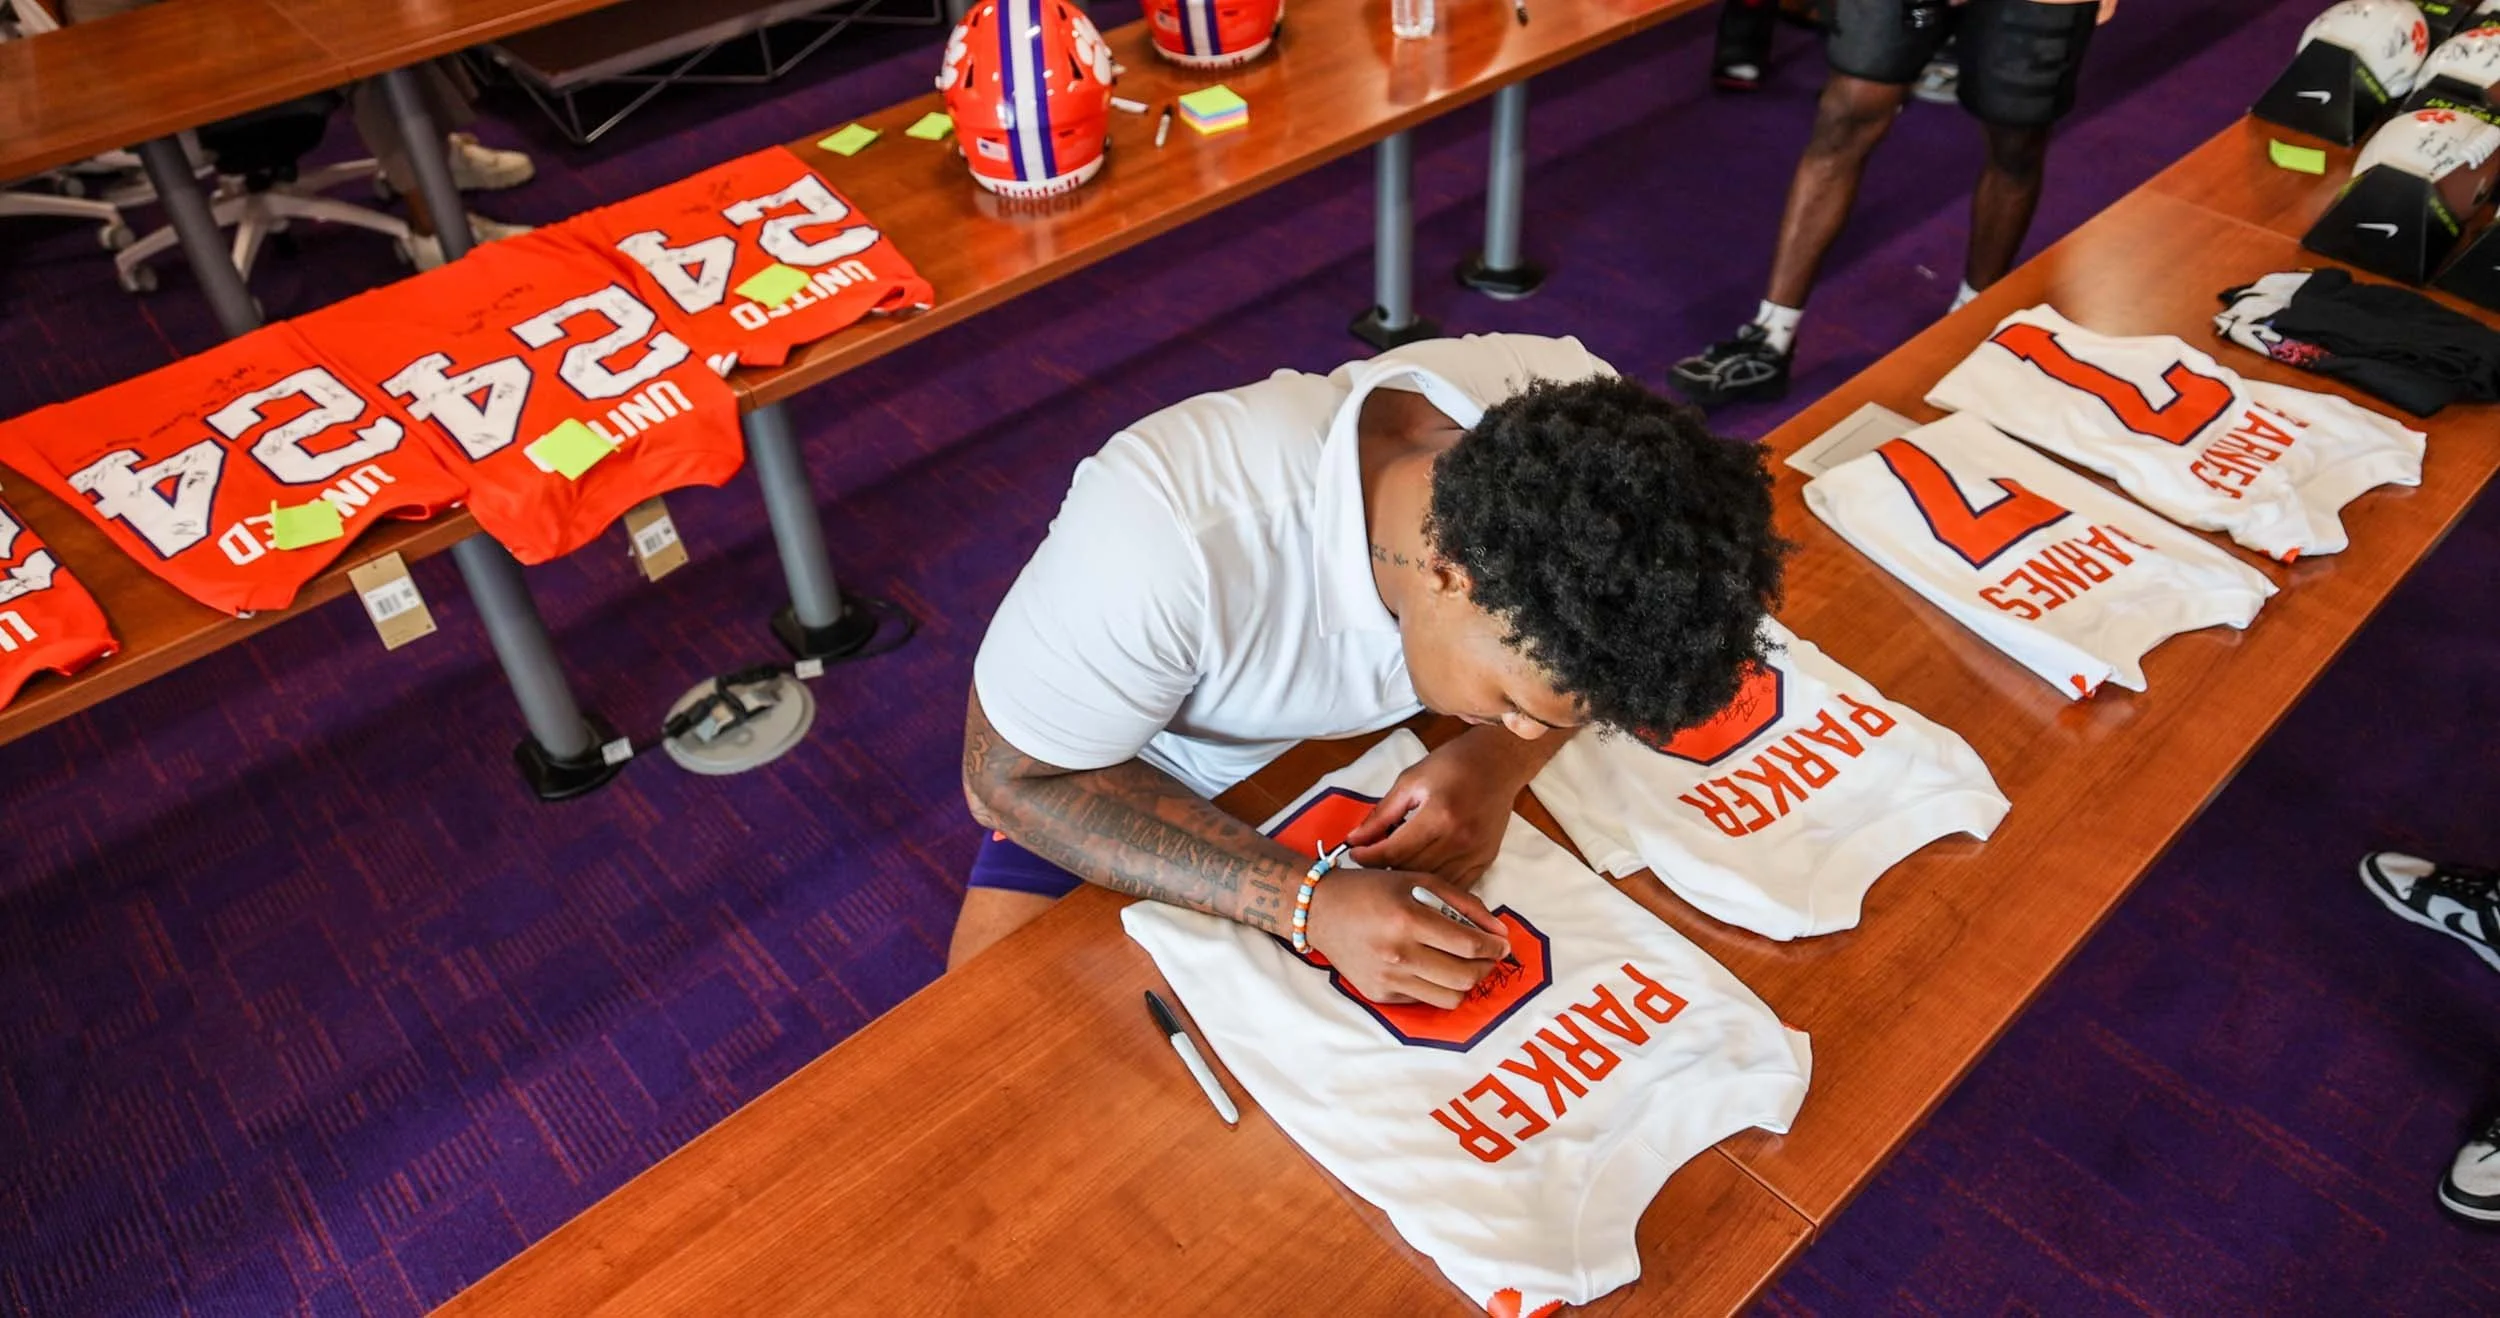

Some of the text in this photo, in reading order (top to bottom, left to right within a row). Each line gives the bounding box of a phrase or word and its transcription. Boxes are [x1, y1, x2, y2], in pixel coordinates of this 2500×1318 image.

[614, 172, 881, 316] 24
[379, 280, 693, 463] 24
[1991, 323, 2237, 447] 7
[66, 364, 405, 560] 24
[1874, 437, 2074, 570] 7
[2189, 401, 2310, 500] ARNES
[1977, 524, 2158, 621] ARNES
[1677, 693, 1898, 838] PARKER
[1428, 963, 1689, 1163] PARKER
